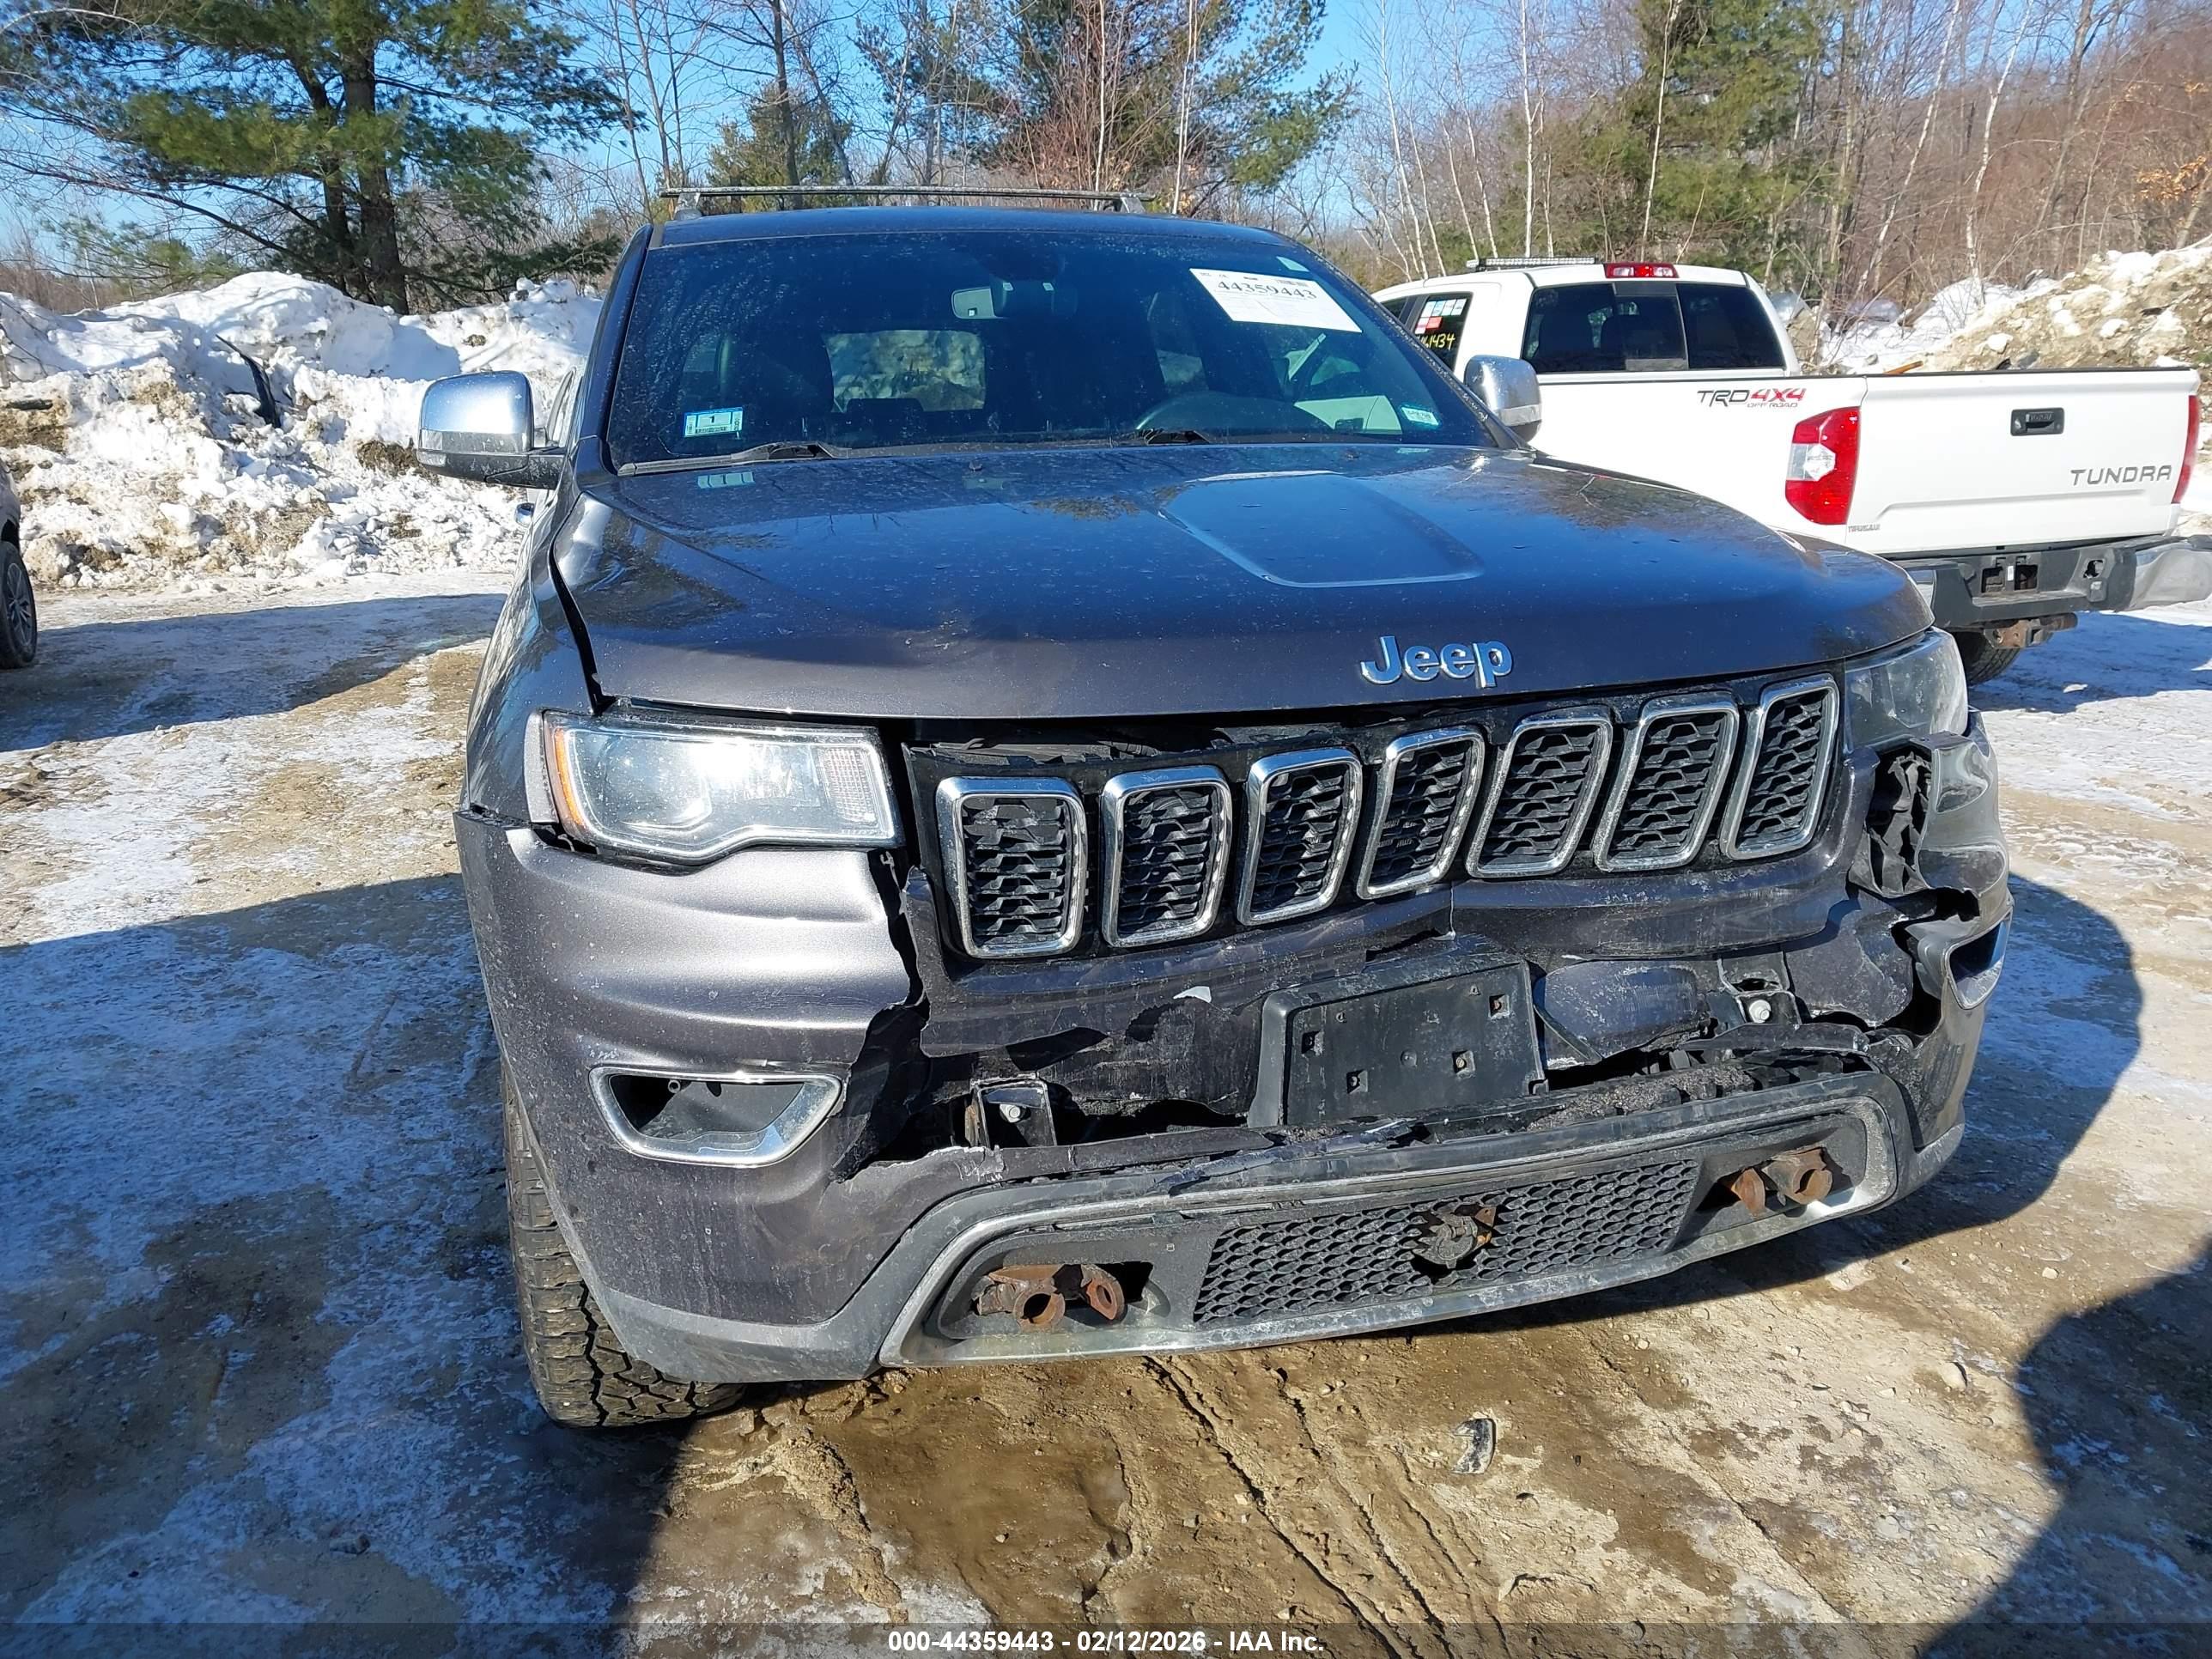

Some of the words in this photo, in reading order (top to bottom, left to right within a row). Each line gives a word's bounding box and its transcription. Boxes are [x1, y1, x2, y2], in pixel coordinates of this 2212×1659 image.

[1218, 280, 1317, 300] 44359443
[1697, 389, 1750, 408] TRD
[2070, 465, 2172, 486] TUNDRA
[1360, 635, 1513, 688] Jeep
